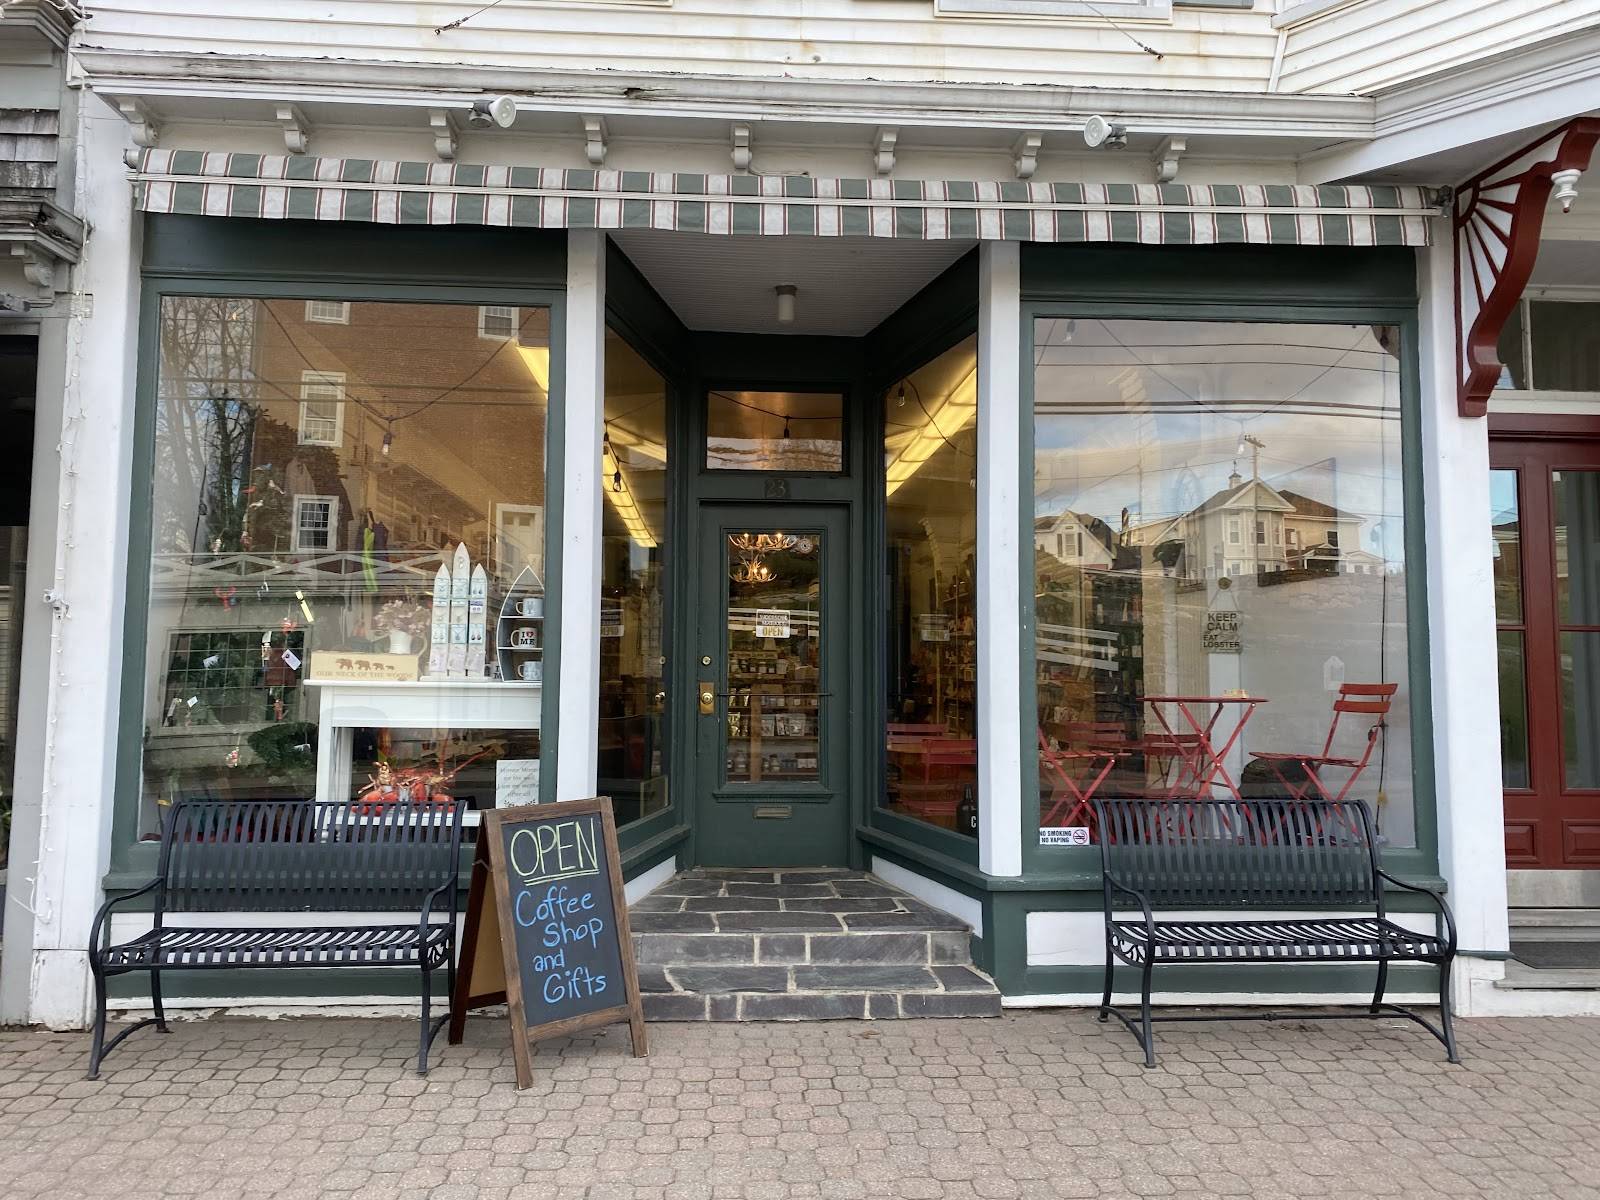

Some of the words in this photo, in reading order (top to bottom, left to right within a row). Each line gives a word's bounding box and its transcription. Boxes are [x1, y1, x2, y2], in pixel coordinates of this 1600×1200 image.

[763, 626, 783, 636] OPEN
[1207, 613, 1237, 622] KEEP
[1207, 622, 1238, 631] CALM
[510, 817, 599, 876] OPEN
[515, 885, 595, 927] Coffee
[542, 917, 603, 948] Shop
[532, 948, 565, 972] and
[543, 966, 607, 1003] Gifts
